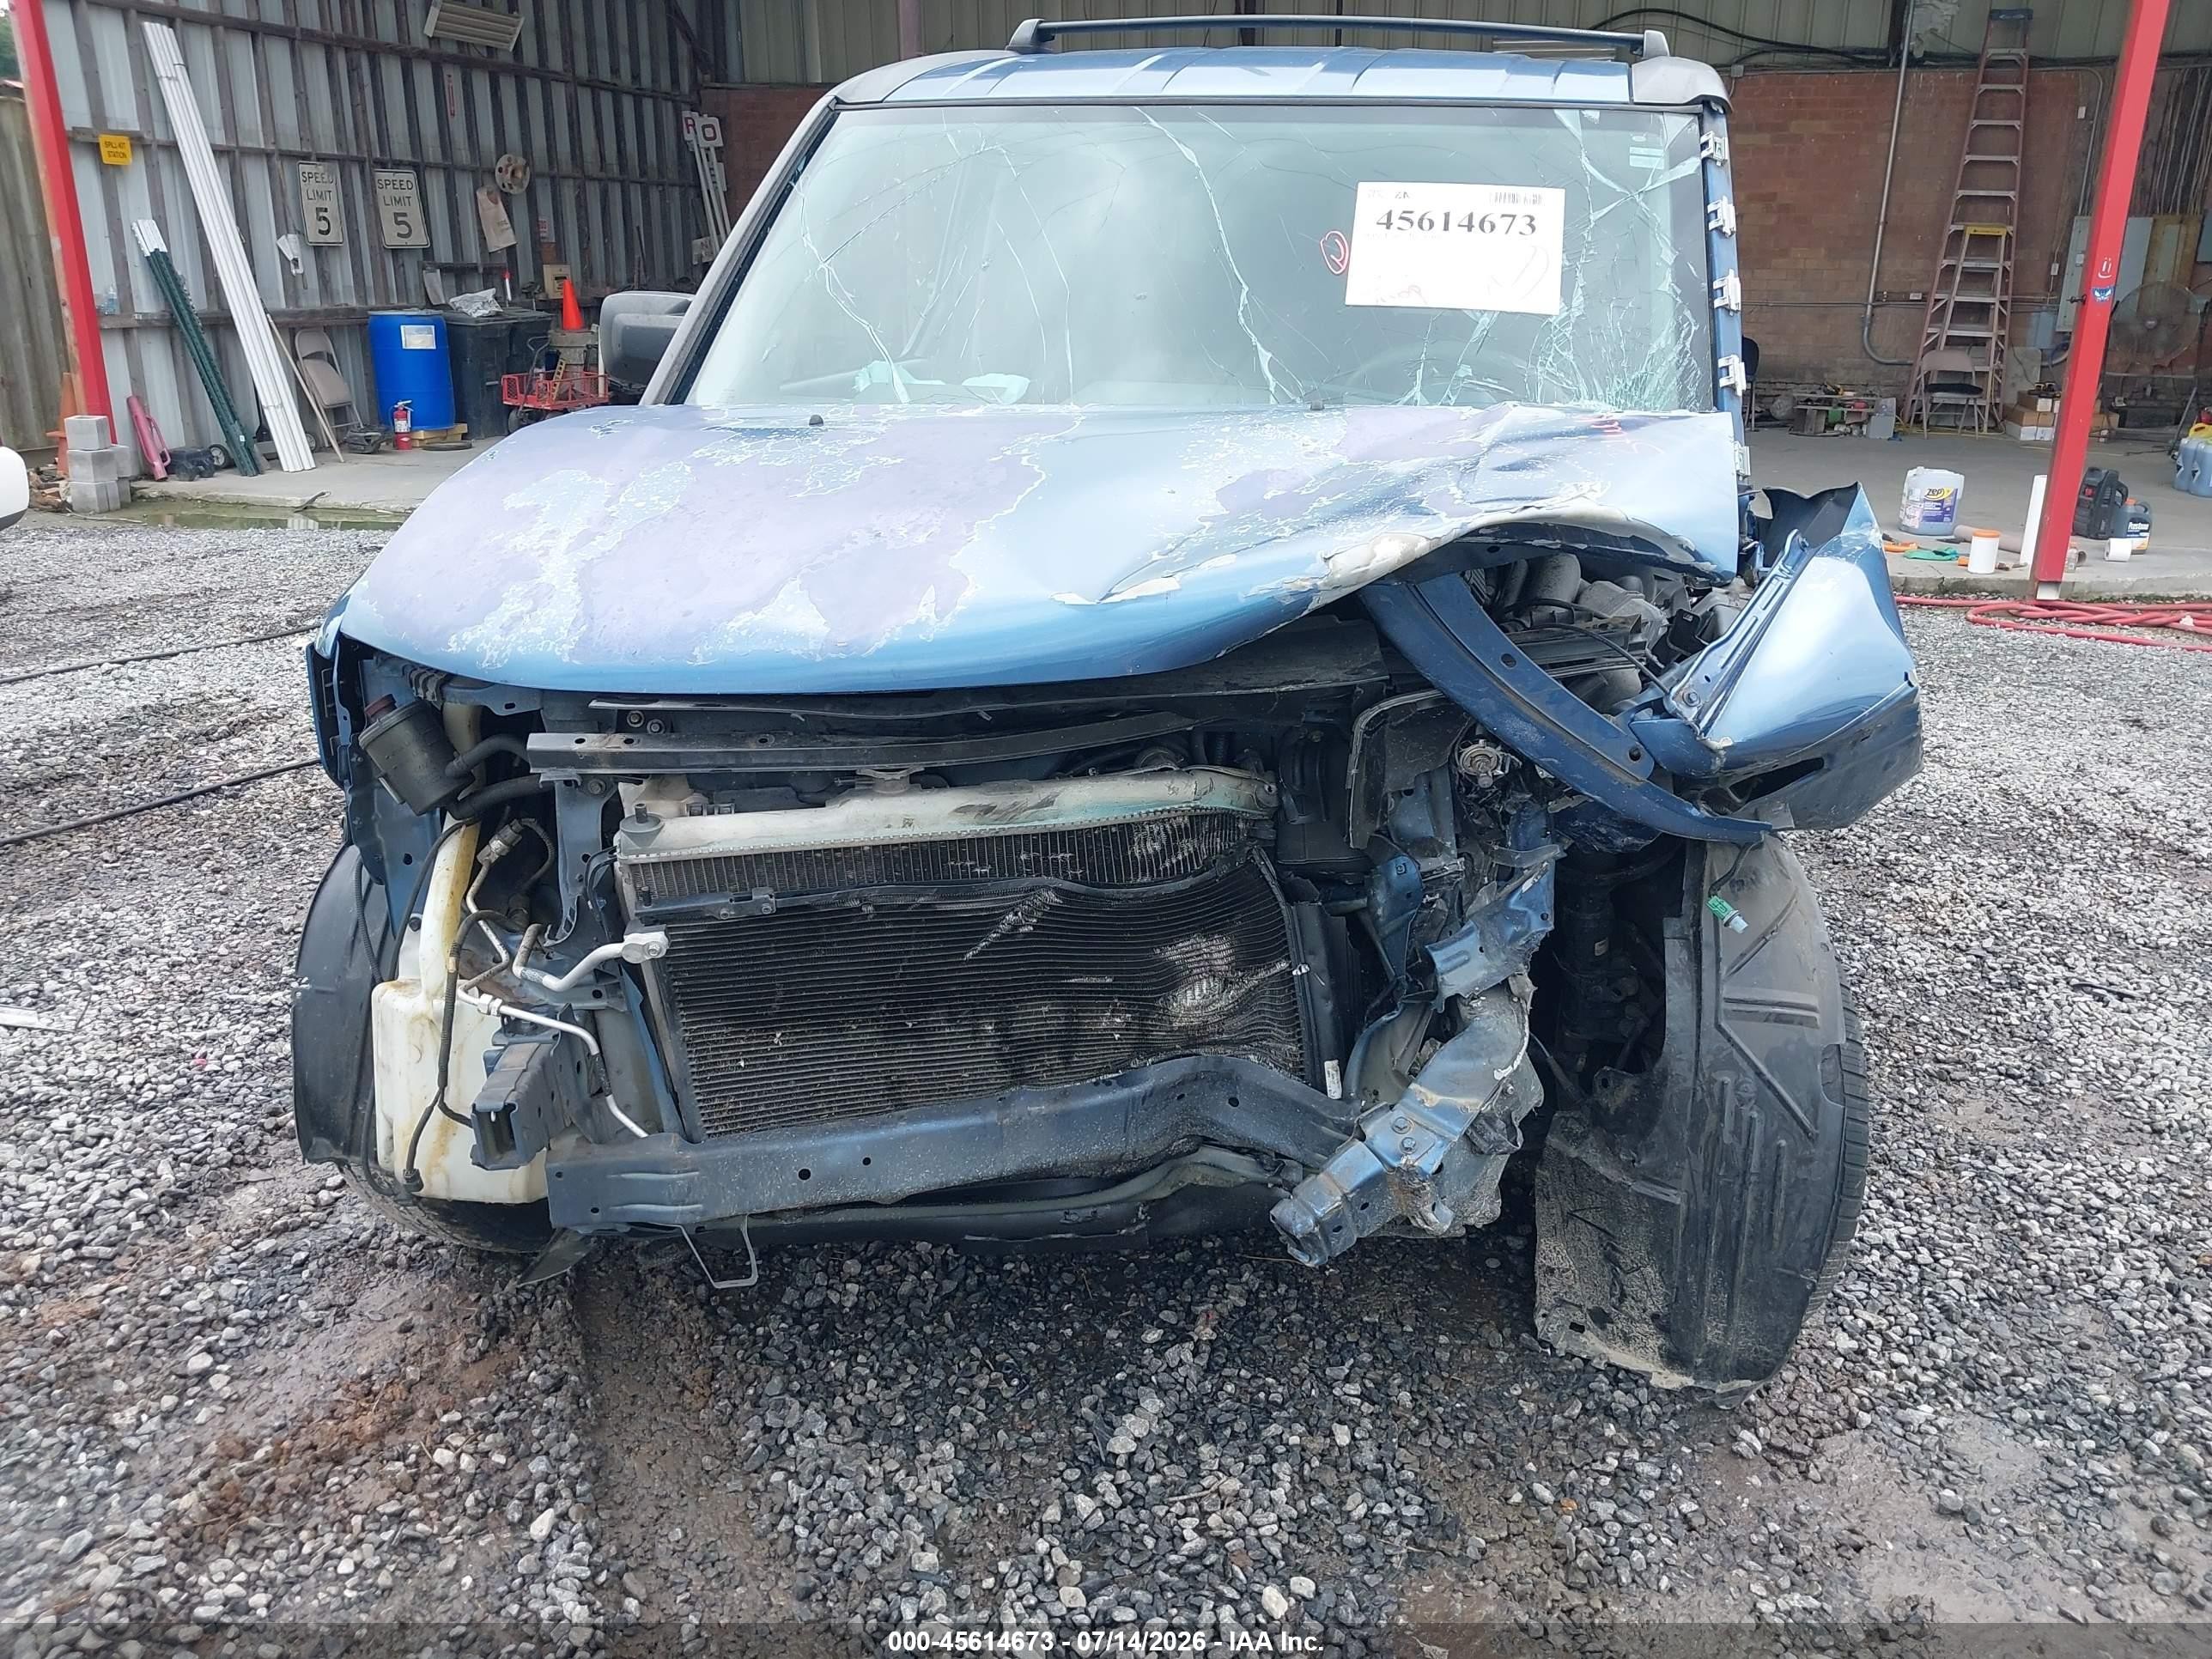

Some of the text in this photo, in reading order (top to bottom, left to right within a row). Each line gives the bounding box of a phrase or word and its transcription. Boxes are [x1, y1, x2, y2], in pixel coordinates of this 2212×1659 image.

[301, 171, 334, 184] SPEED
[377, 179, 414, 190] SPEED
[306, 189, 332, 201] LIMIT
[383, 196, 412, 207] LIMIT
[315, 207, 331, 235] 5
[392, 212, 413, 239] 5
[1376, 209, 1537, 236] 45614673
